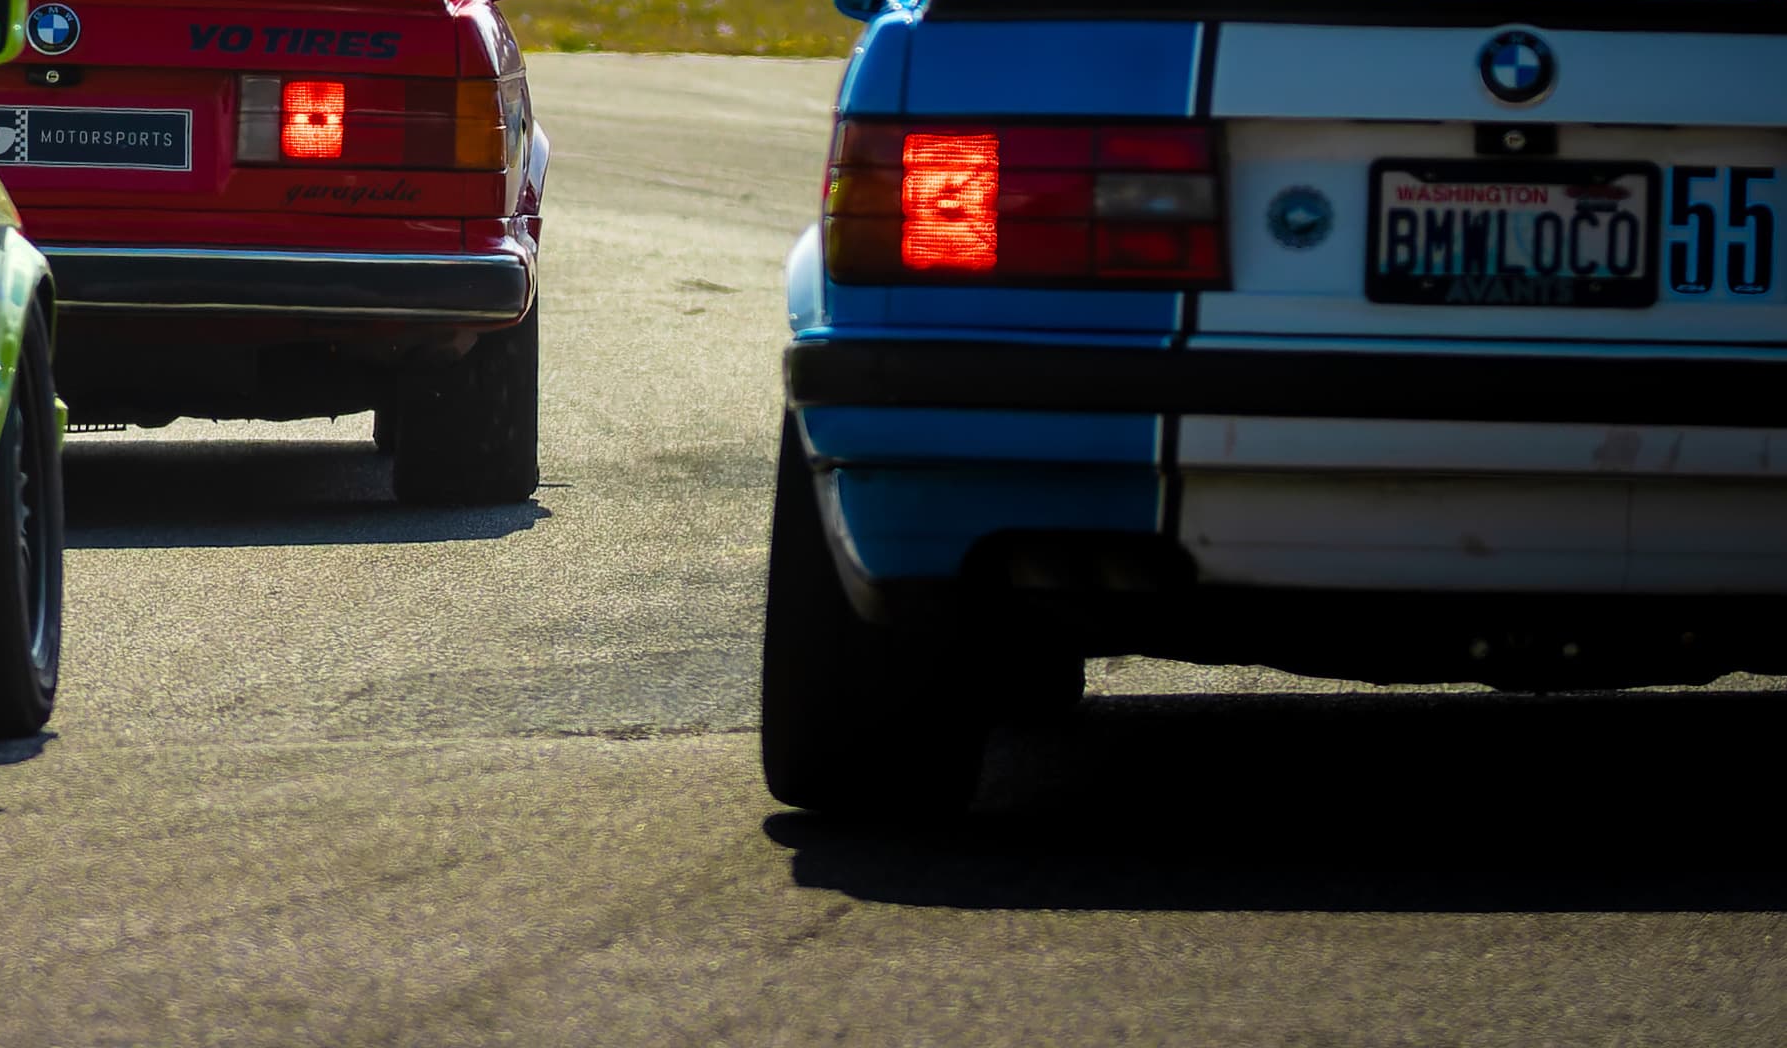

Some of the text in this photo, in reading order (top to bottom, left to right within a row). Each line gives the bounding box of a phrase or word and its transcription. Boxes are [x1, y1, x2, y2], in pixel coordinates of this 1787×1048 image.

[188, 24, 403, 59] YO TIRES
[39, 129, 174, 147] MOTORSPORTS
[1395, 184, 1550, 205] WASHINGTON
[1386, 208, 1640, 276] BMWLOCO
[1670, 166, 1776, 294] 55
